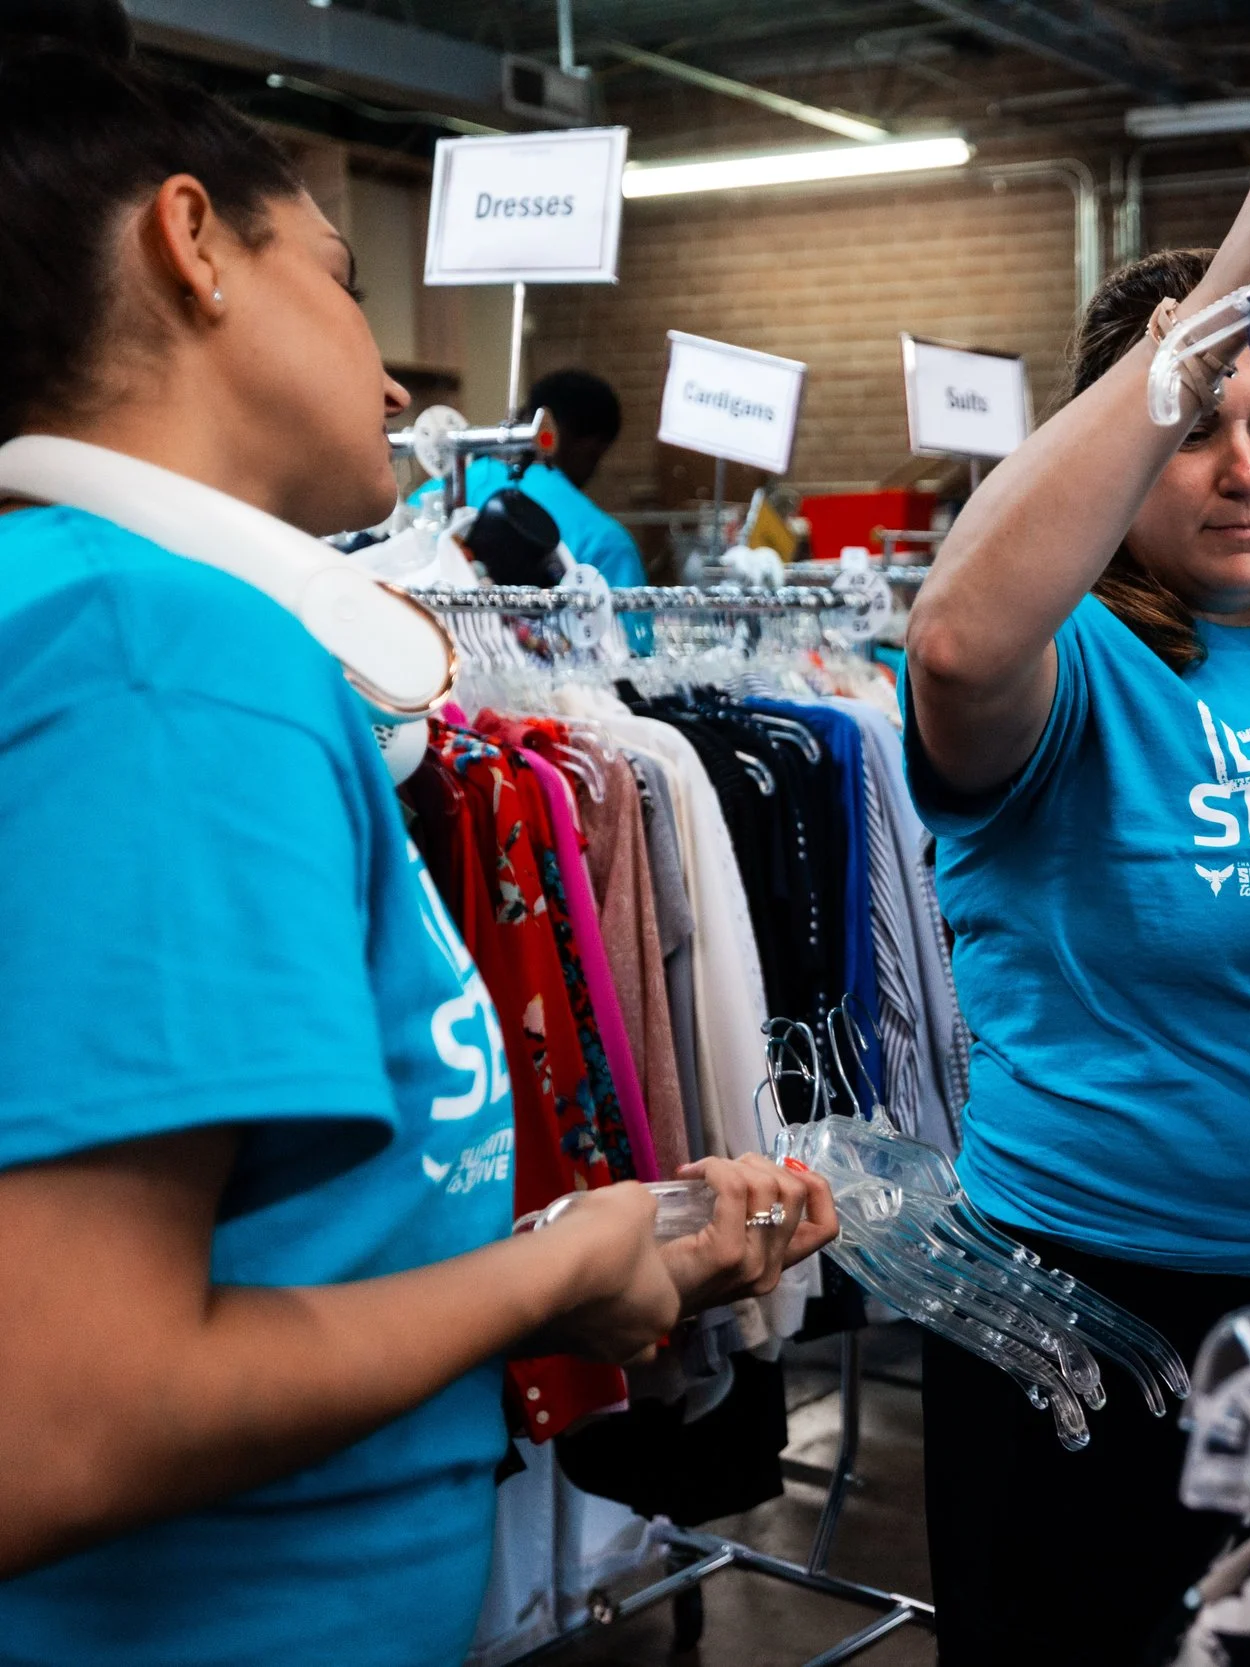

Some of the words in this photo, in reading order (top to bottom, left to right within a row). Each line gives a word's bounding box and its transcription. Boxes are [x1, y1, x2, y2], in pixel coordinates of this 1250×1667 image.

[475, 192, 574, 219] Dresses
[683, 380, 775, 421] Cardigans
[945, 386, 988, 413] Suits
